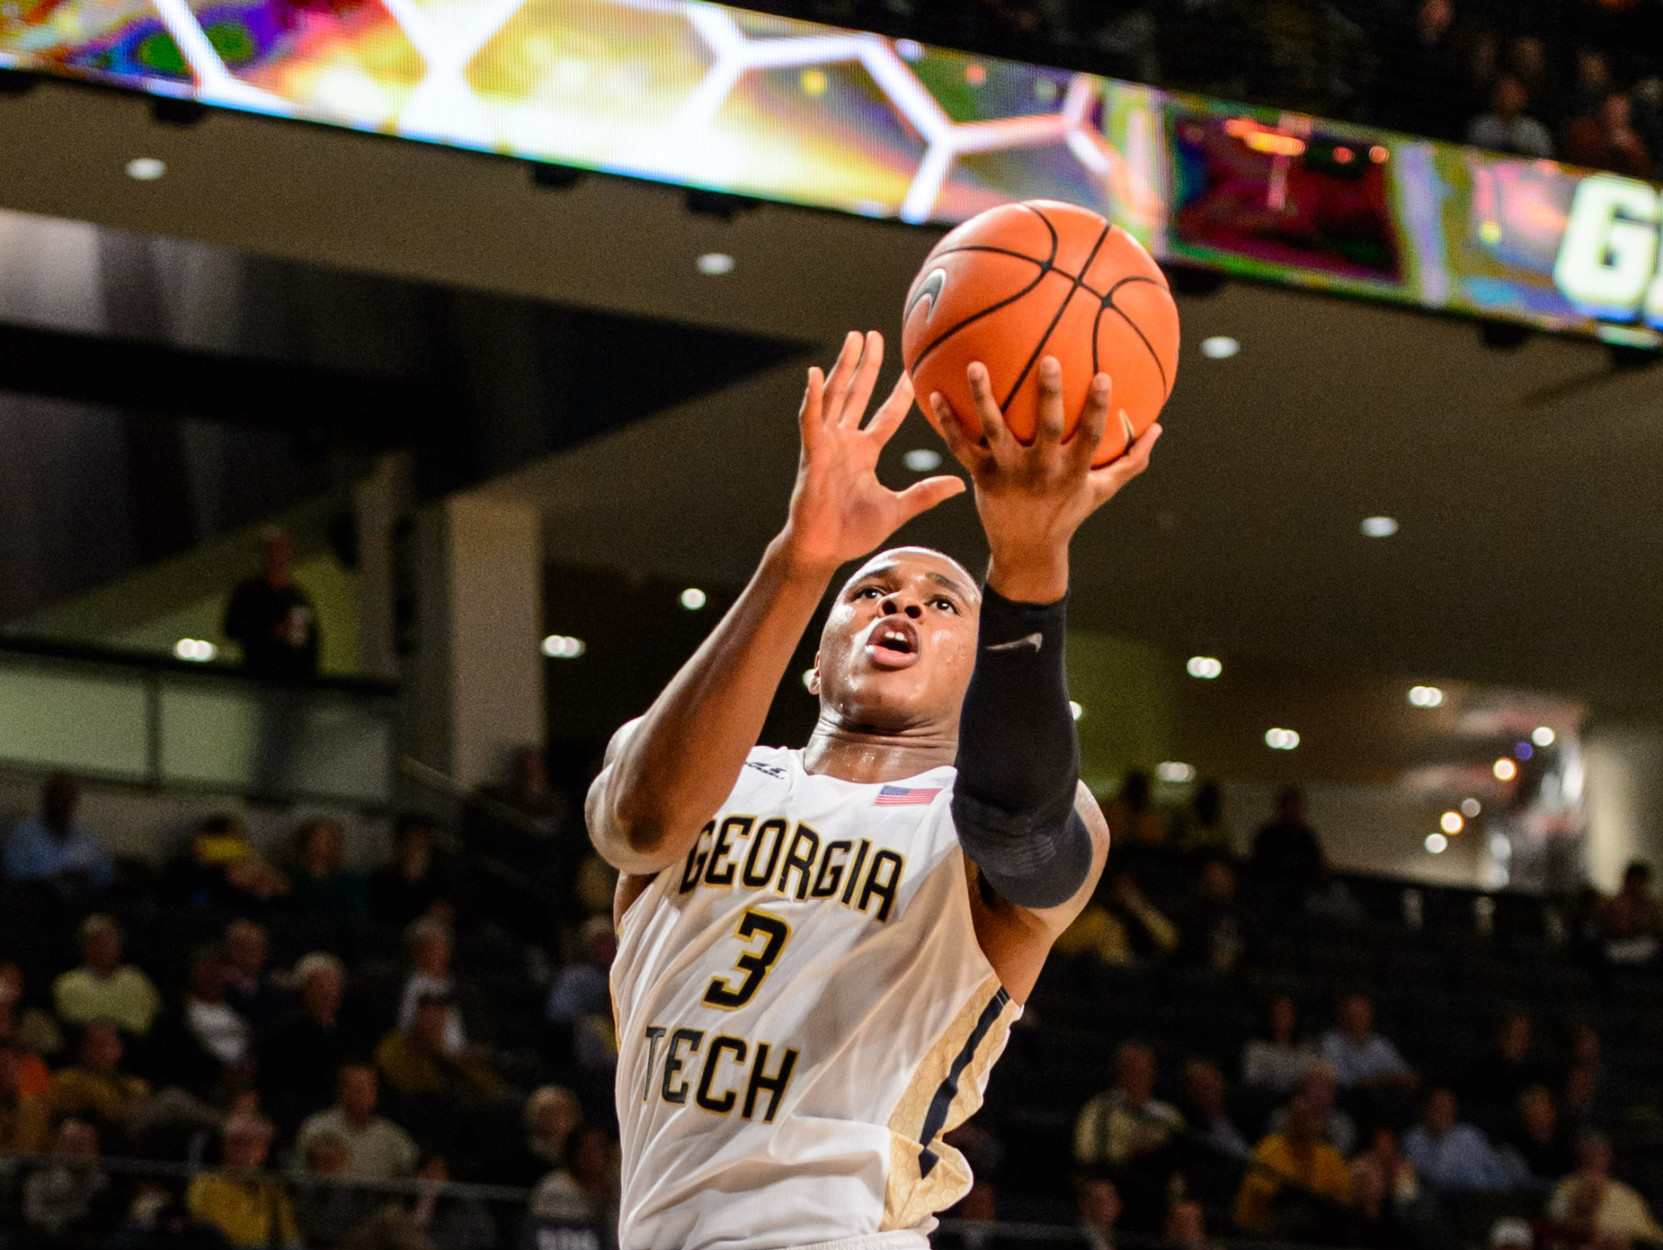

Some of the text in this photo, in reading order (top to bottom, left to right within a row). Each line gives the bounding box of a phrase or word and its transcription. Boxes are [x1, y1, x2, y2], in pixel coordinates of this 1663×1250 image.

[1552, 172, 1663, 318] G
[679, 813, 906, 924] GEORGIA
[700, 906, 792, 1012] 3
[641, 1025, 799, 1125] TECH
